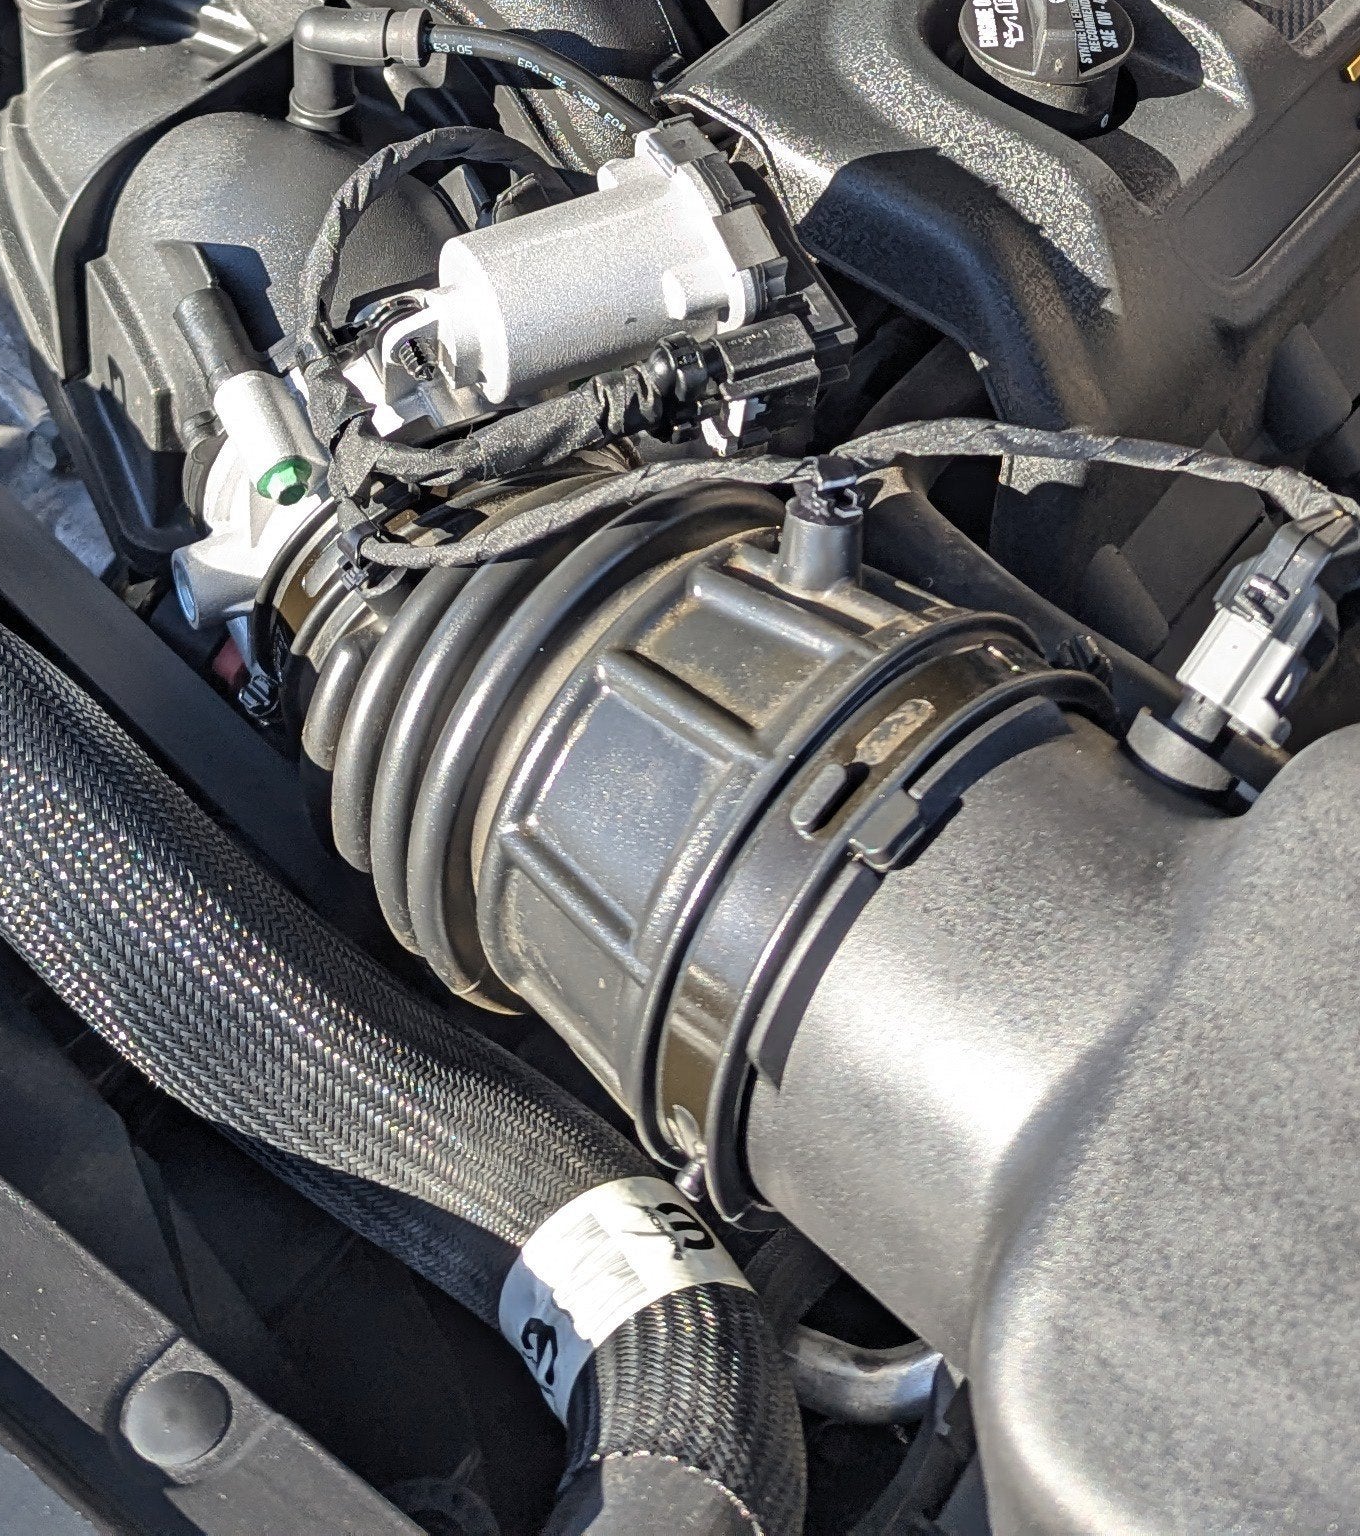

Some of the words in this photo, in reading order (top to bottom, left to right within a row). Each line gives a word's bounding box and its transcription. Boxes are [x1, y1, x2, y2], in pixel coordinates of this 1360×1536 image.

[974, 7, 999, 48] ENGINE
[1073, 19, 1093, 64] SYNTHETIC
[1099, 28, 1119, 48] SAE
